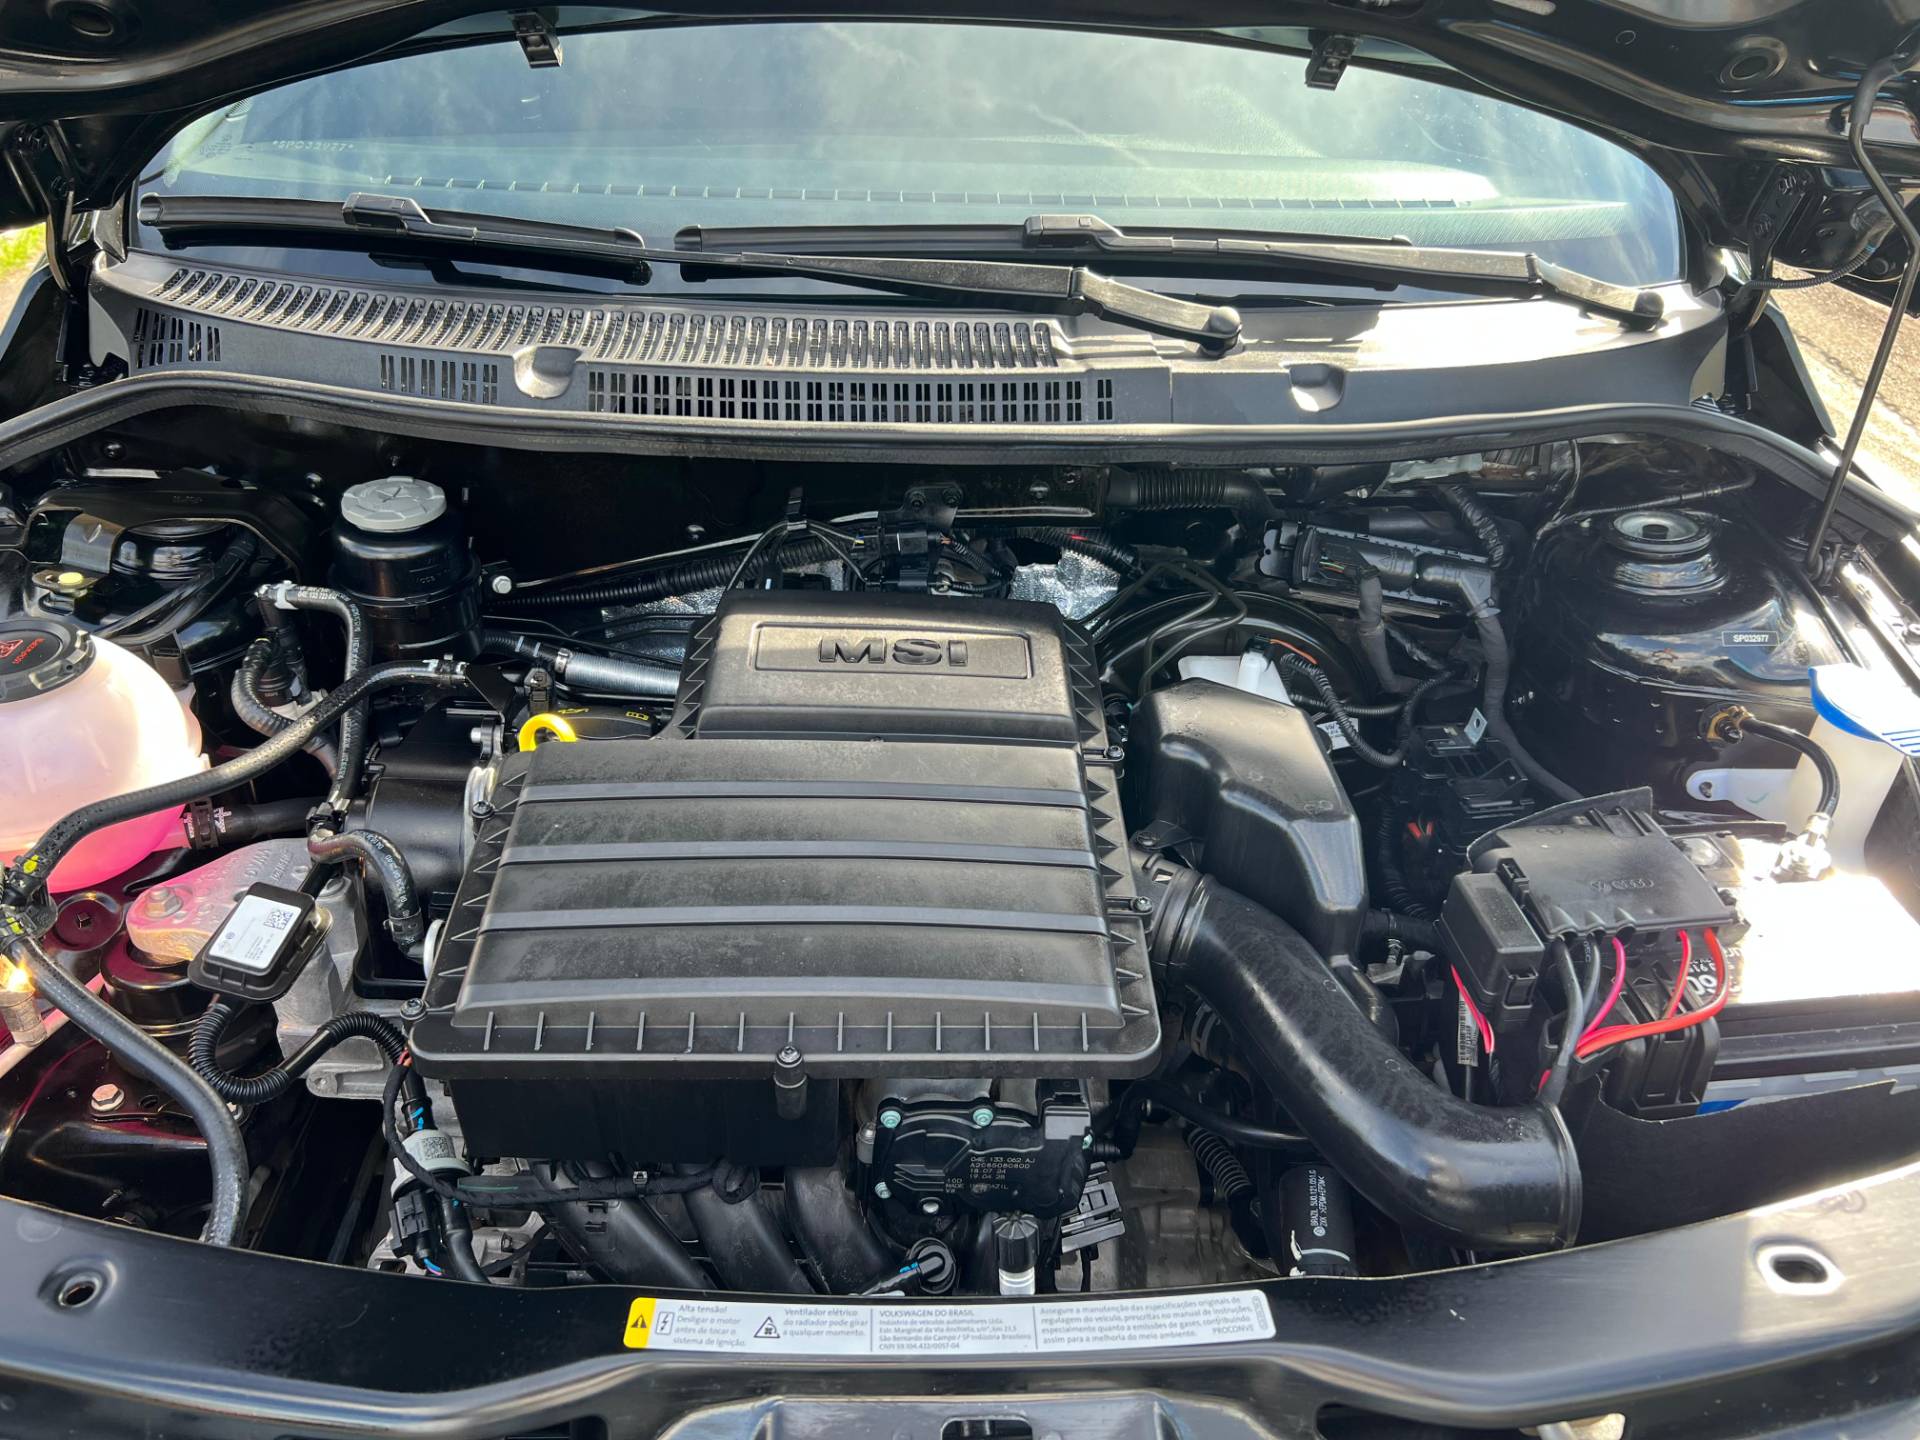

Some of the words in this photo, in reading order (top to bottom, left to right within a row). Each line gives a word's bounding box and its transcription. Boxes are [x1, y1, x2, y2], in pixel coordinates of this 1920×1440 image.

[818, 637, 968, 666] MSI
[679, 1304, 696, 1312] Alta
[784, 1308, 826, 1317] Ventilador
[879, 1309, 934, 1318] VOLKSWAGEN
[935, 1309, 948, 1318] DO
[949, 1309, 975, 1318] BRASIL
